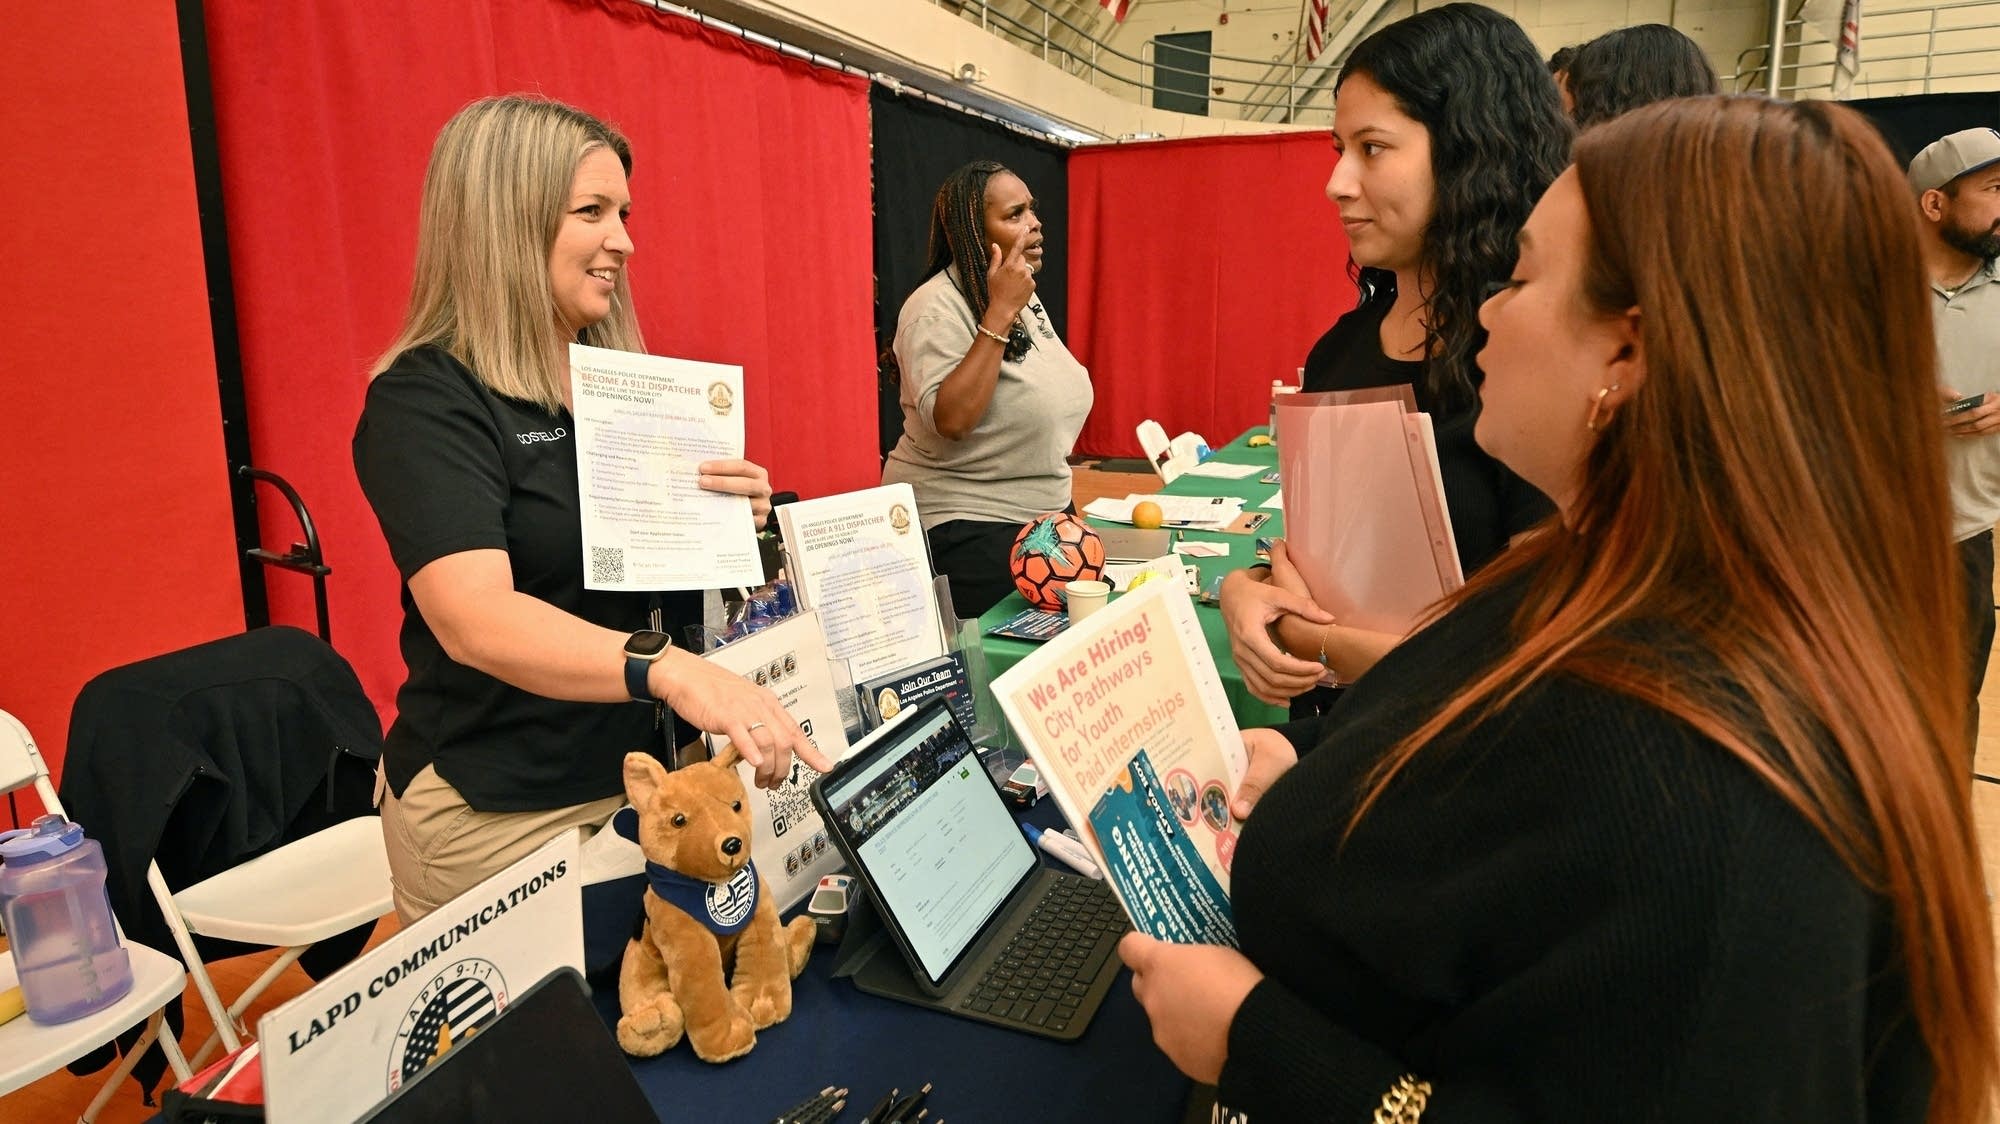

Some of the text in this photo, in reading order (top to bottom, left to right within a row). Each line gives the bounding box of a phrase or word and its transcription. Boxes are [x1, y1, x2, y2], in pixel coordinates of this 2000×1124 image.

[582, 374, 701, 396] BECOME A 911 DISPATCHER
[596, 391, 632, 402] OPENINGS
[634, 396, 655, 404] NOW!
[638, 374, 675, 383] DEPARTMENT
[803, 527, 828, 538] BECOME
[834, 524, 846, 533] 911
[848, 516, 884, 530] DISPATCHER
[838, 513, 864, 523] DEPARTMENT
[806, 544, 814, 552] JOB
[816, 539, 838, 550] OPENINGS
[901, 669, 952, 694] Join Our Team
[1028, 684, 1057, 712] We
[1057, 662, 1088, 692] Are
[1088, 612, 1152, 666] Hiring!
[908, 692, 923, 702] Angeles
[923, 688, 936, 696] Police
[936, 680, 958, 692] Department
[1044, 649, 1153, 739] City Pathways
[1060, 701, 1124, 768] for Youth
[1076, 758, 1108, 794] Paid
[1105, 690, 1186, 775] Internships
[1133, 762, 1173, 833] APLICA HOY
[1113, 826, 1158, 920] HIRING
[1126, 832, 1149, 880] Equipo
[1128, 821, 1156, 876] Parques
[1157, 821, 1189, 877] Crecimiento
[1176, 844, 1214, 904] Emocionante
[1148, 842, 1203, 935] Posiciones Abiertas
[1150, 880, 1179, 934] Nuestro
[1153, 878, 1163, 887] y
[1188, 878, 1197, 890] de
[1189, 893, 1216, 930] Flexible
[288, 860, 568, 1054] LAPD COMMUNICATIONS
[400, 962, 492, 1038] LAPD 9-1-1
